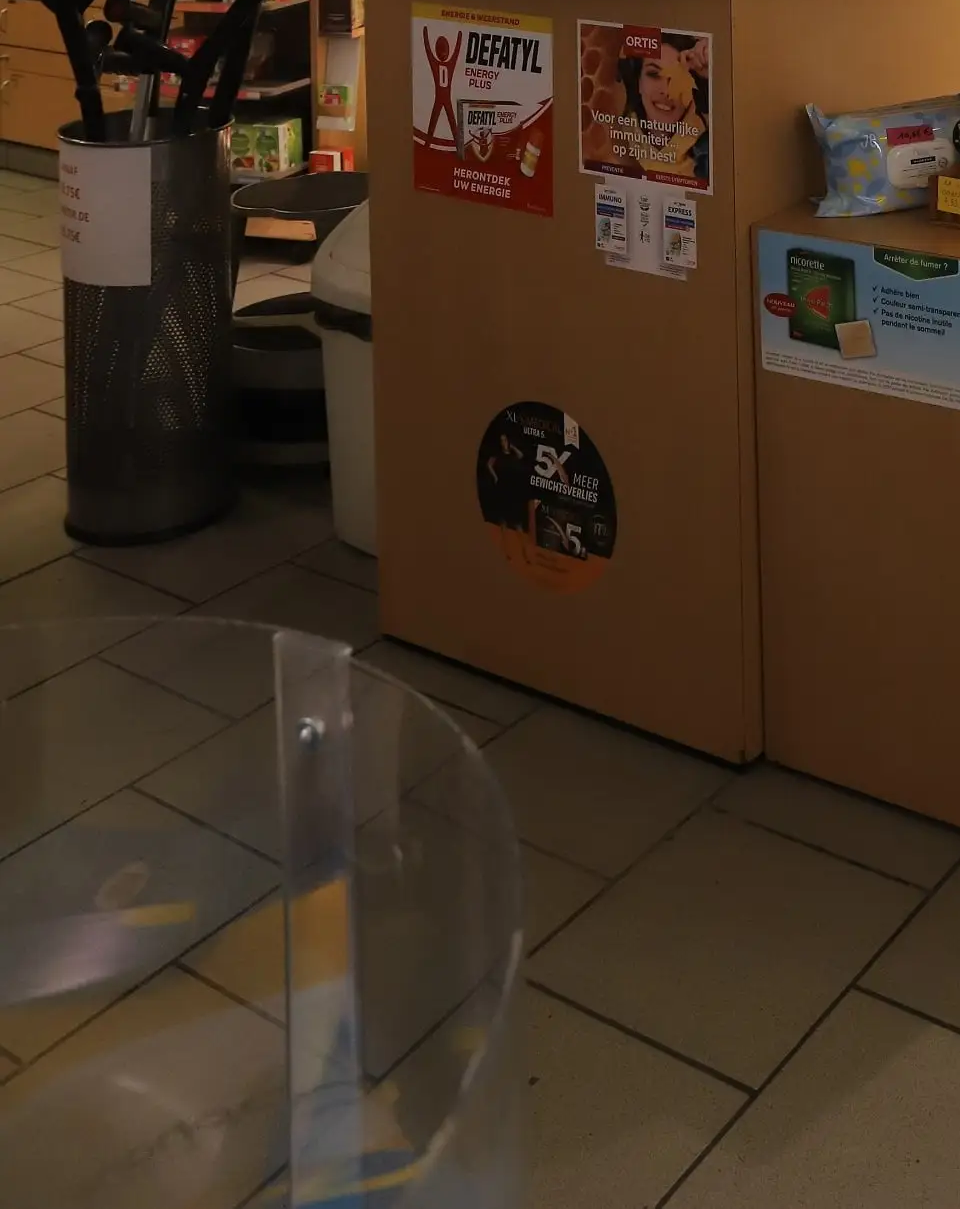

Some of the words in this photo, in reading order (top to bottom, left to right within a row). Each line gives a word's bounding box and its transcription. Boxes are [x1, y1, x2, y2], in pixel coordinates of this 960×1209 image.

[441, 9, 470, 20] ENERGIE
[477, 14, 520, 26] WEERSTAND
[625, 36, 659, 50] ORTIS
[465, 31, 542, 74] DEFATYL
[439, 65, 449, 88] D
[464, 67, 500, 81] ENERGY
[469, 78, 492, 90] PLUS
[467, 110, 497, 126] DEFATYL
[496, 111, 517, 119] ENERGY
[591, 109, 616, 124] Voor
[618, 116, 638, 128] een
[640, 118, 700, 137] natuurlijke
[613, 145, 627, 156] op
[628, 146, 648, 161] zijn
[651, 147, 677, 163] best!
[453, 167, 511, 187] HERONTDEK
[453, 180, 469, 191] UW
[470, 183, 511, 199] ENERGIE
[598, 194, 622, 204] IMMUNO
[668, 206, 692, 217] EXPRESS
[790, 255, 825, 271] nicorette
[883, 253, 909, 265] Arrêter
[910, 257, 920, 266] de
[920, 259, 942, 270] fumer
[943, 261, 949, 271] ?
[880, 297, 907, 309] Couleur
[905, 290, 920, 300] bien
[881, 308, 894, 318] Pas
[895, 311, 904, 319] de
[904, 312, 931, 324] nicotine
[881, 319, 909, 331] pendant
[909, 321, 916, 329] le
[523, 427, 540, 437] ULTRA
[533, 443, 572, 484] 5X
[529, 474, 599, 503] GEWICHTSVERLIES
[573, 472, 600, 491] MEER
[566, 522, 582, 556] 5
